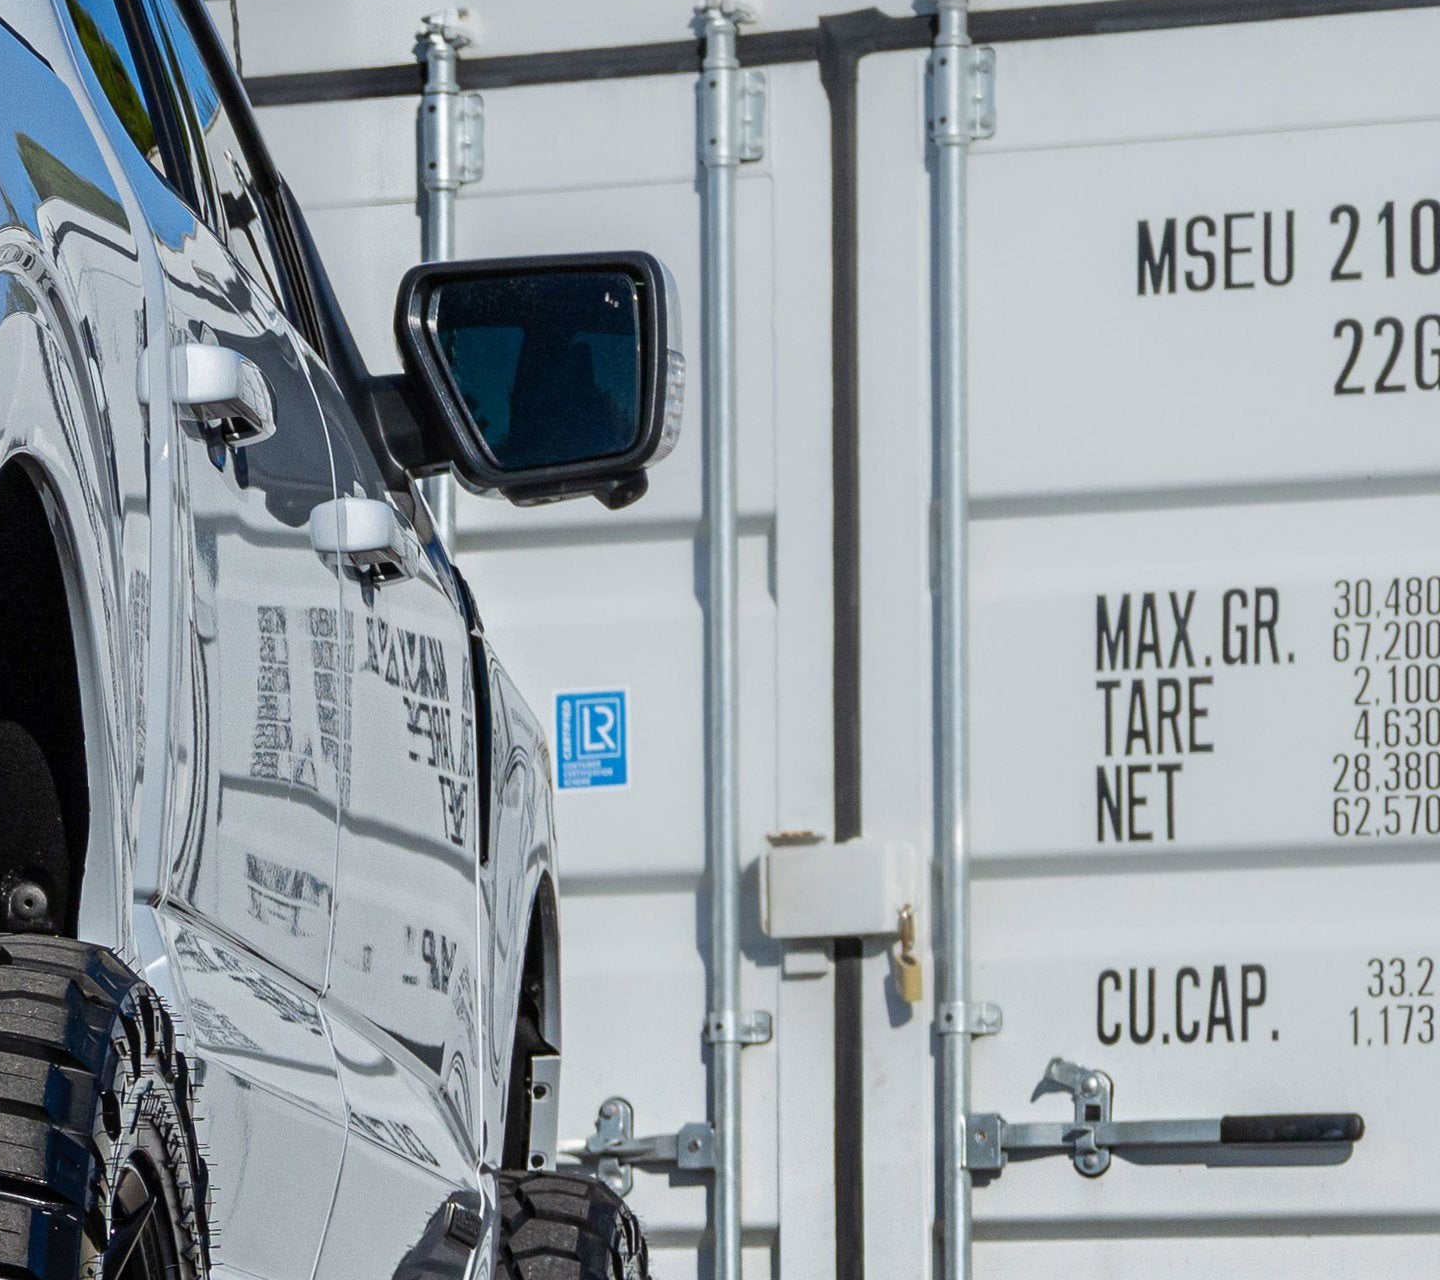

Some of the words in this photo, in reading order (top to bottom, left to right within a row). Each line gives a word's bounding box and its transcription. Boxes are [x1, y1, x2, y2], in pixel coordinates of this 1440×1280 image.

[1137, 210, 1295, 296] MSEU
[1329, 198, 1440, 282] 210
[582, 705, 617, 752] LR
[1095, 675, 1214, 757] TARE
[1096, 763, 1183, 843] NET
[1367, 957, 1435, 998] 33.2
[1349, 1004, 1435, 1047] 1,173
